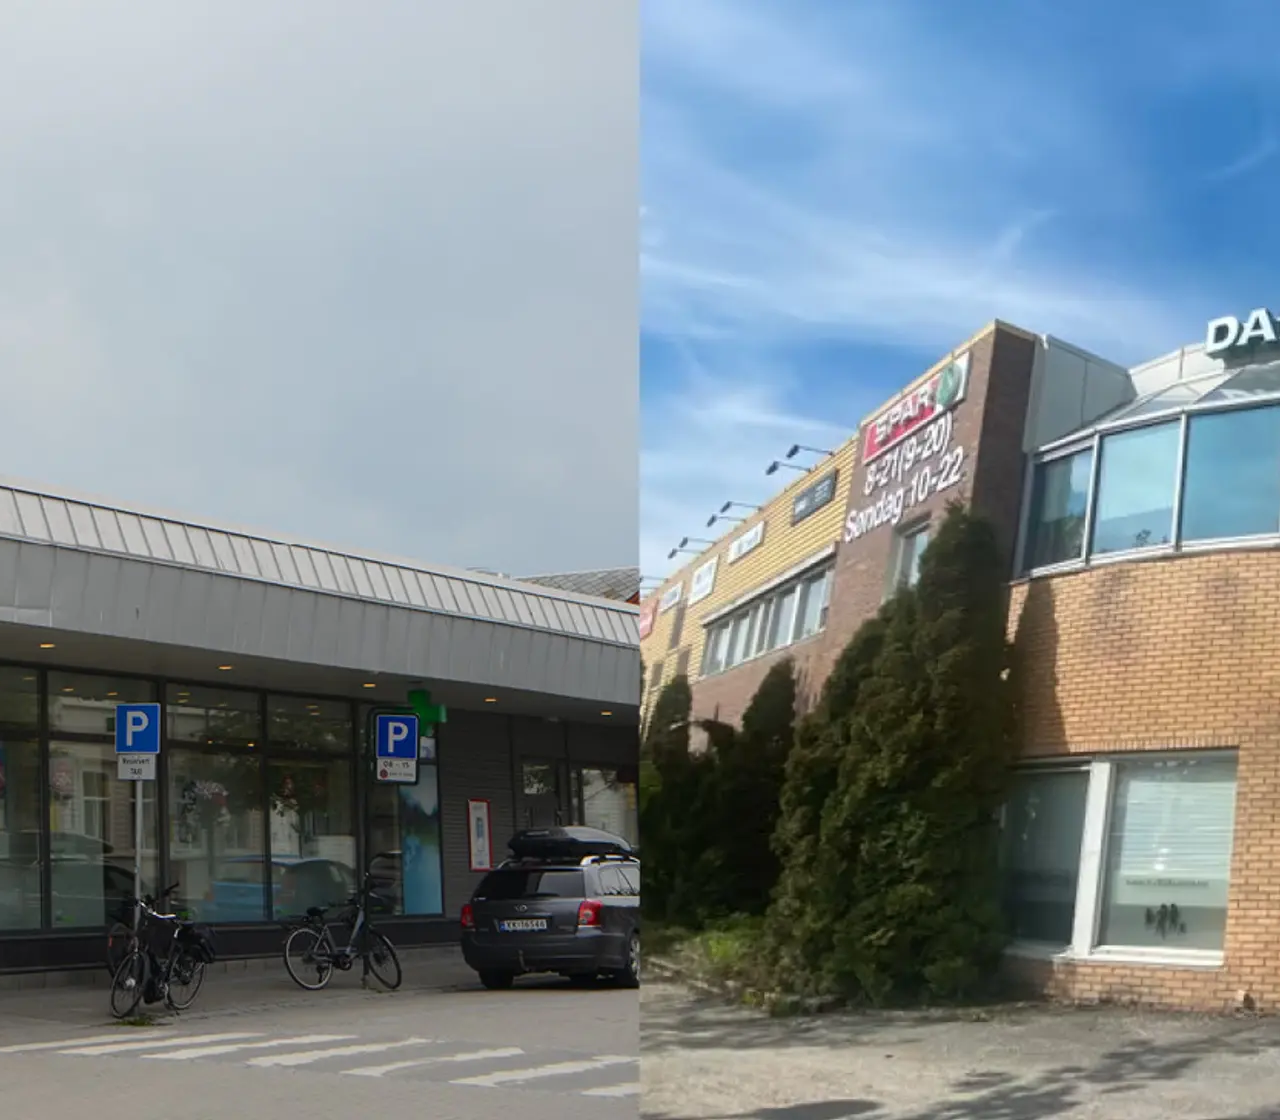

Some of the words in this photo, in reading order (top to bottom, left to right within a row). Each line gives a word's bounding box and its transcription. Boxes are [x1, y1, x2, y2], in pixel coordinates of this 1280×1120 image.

[874, 380, 936, 443] SPAR
[126, 711, 149, 747] P
[388, 721, 409, 753] P
